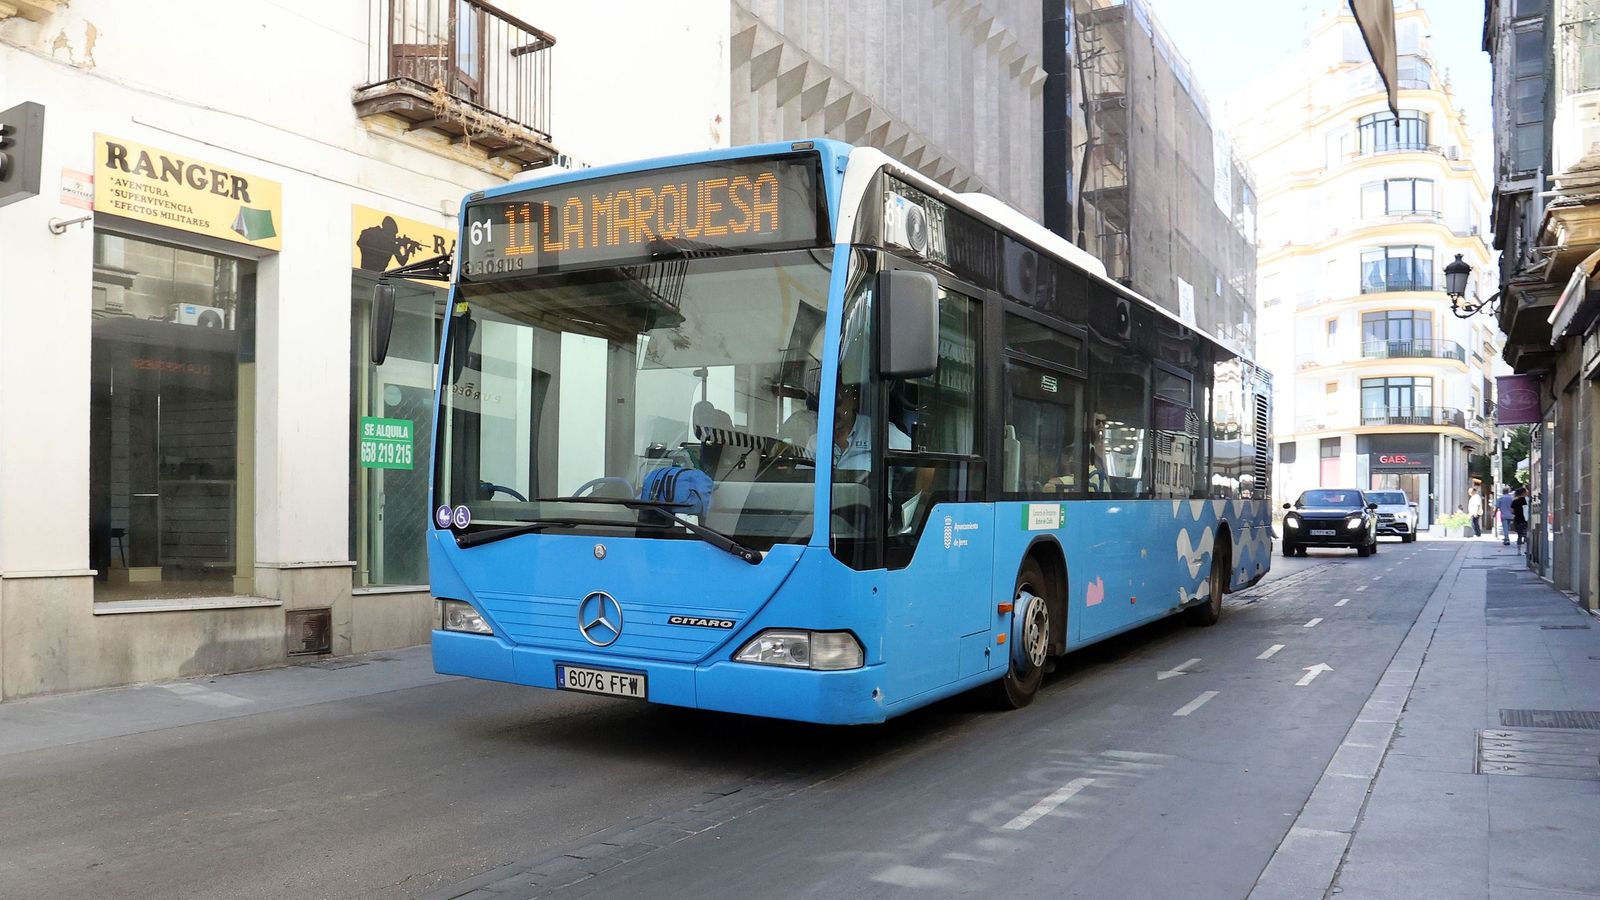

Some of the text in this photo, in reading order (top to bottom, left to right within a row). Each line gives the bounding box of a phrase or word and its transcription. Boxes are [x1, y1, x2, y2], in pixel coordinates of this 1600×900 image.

[105, 141, 252, 203] RANGER
[114, 178, 170, 198] AVENTURA
[114, 189, 194, 214] SUPERVIVENCIA
[504, 172, 779, 256] 11 LA MARQUESA
[114, 200, 210, 229] EFECTOS MILITARES
[470, 218, 493, 247] 61
[364, 423, 409, 438] SE ALQUILA
[361, 441, 412, 464] 658 219 215
[1379, 455, 1407, 464] GAES
[670, 616, 733, 628] CITARO
[569, 669, 638, 695] 6076 FFW
